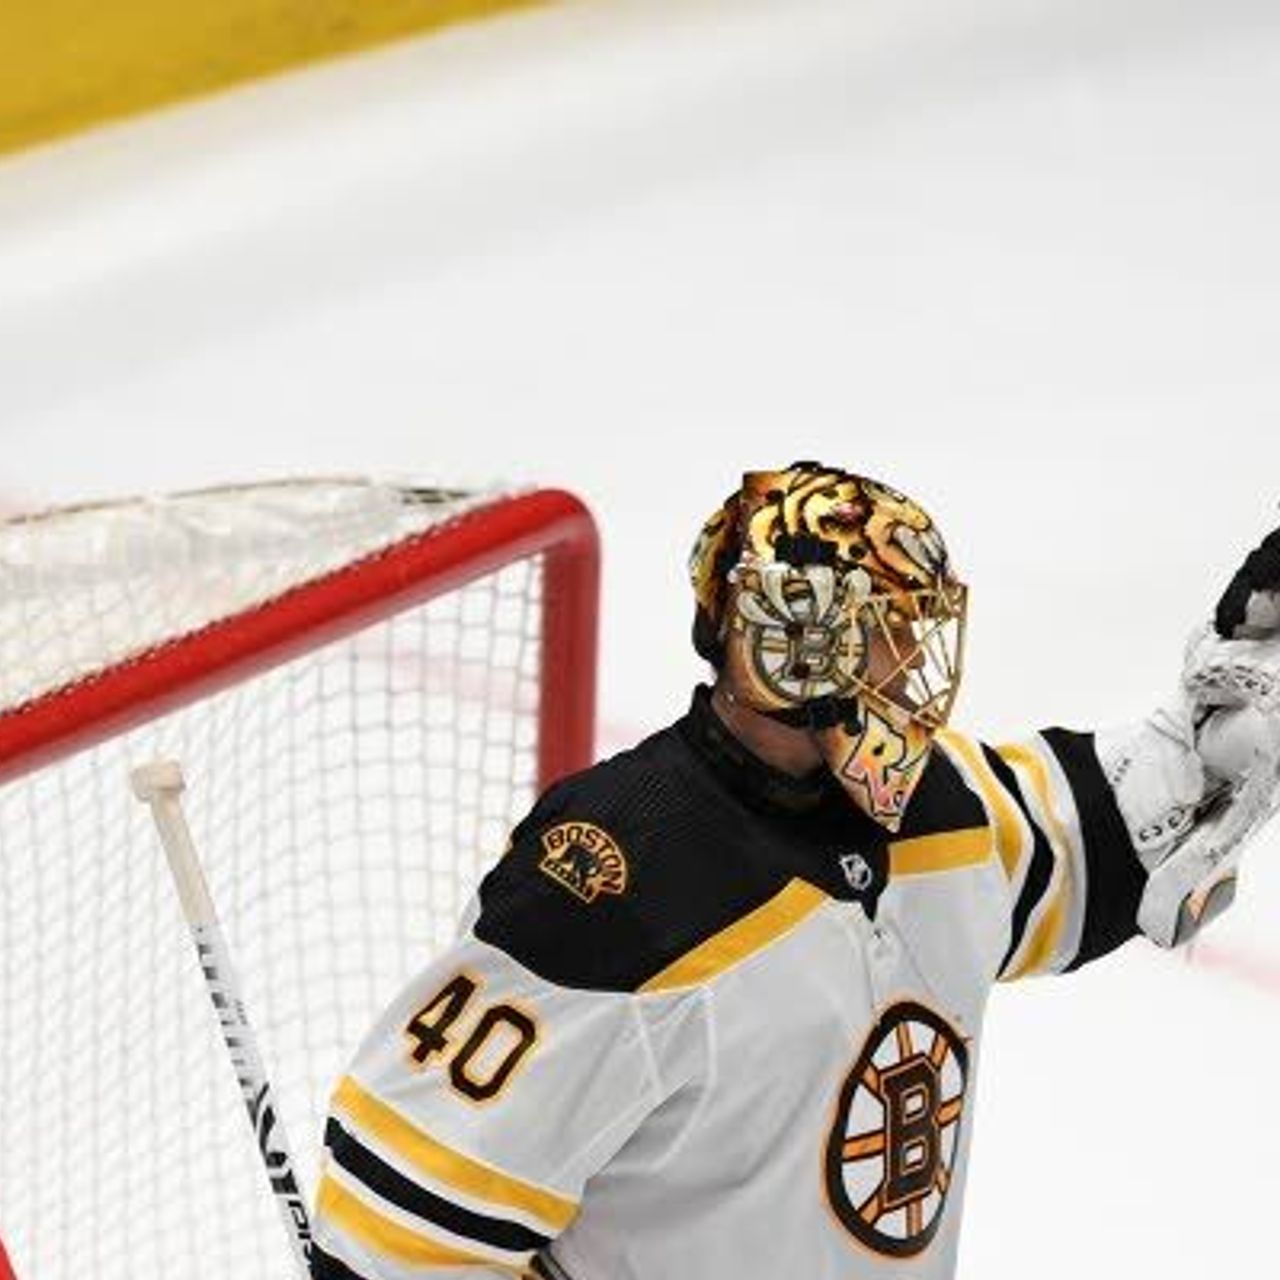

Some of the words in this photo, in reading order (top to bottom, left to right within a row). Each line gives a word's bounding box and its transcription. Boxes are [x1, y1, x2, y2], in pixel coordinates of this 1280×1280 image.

[543, 823, 625, 894] BOSTON
[406, 975, 536, 1102] 40
[878, 1052, 939, 1209] B
